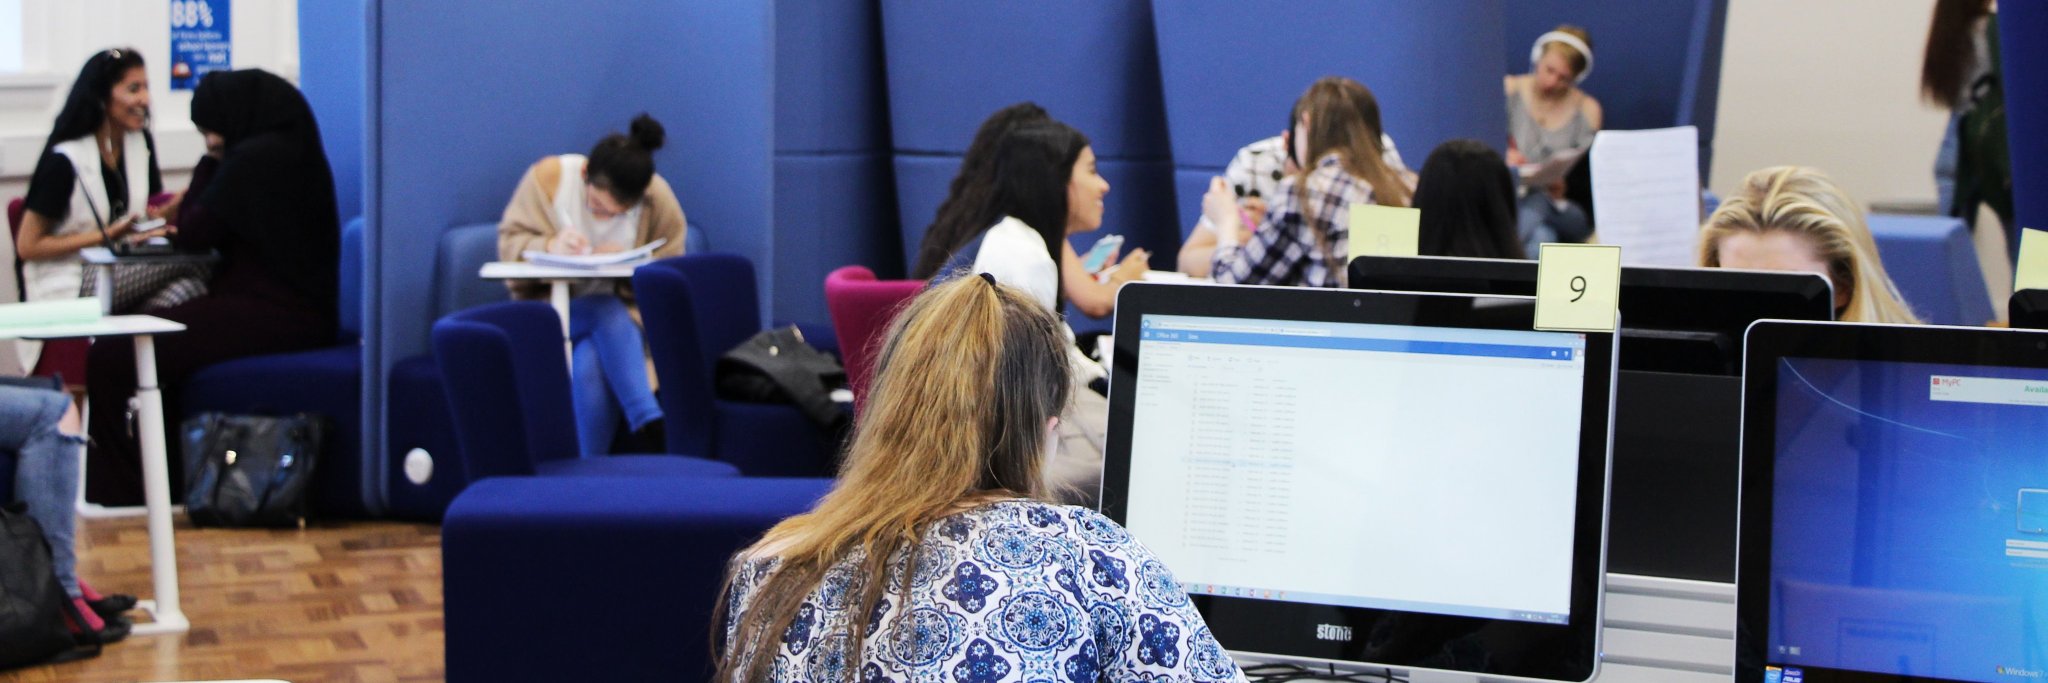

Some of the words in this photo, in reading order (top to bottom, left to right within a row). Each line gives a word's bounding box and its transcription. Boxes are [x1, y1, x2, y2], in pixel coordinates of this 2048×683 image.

[172, 0, 214, 28] 88%
[1570, 275, 1587, 303] 9
[2005, 666, 2039, 678] Windows
